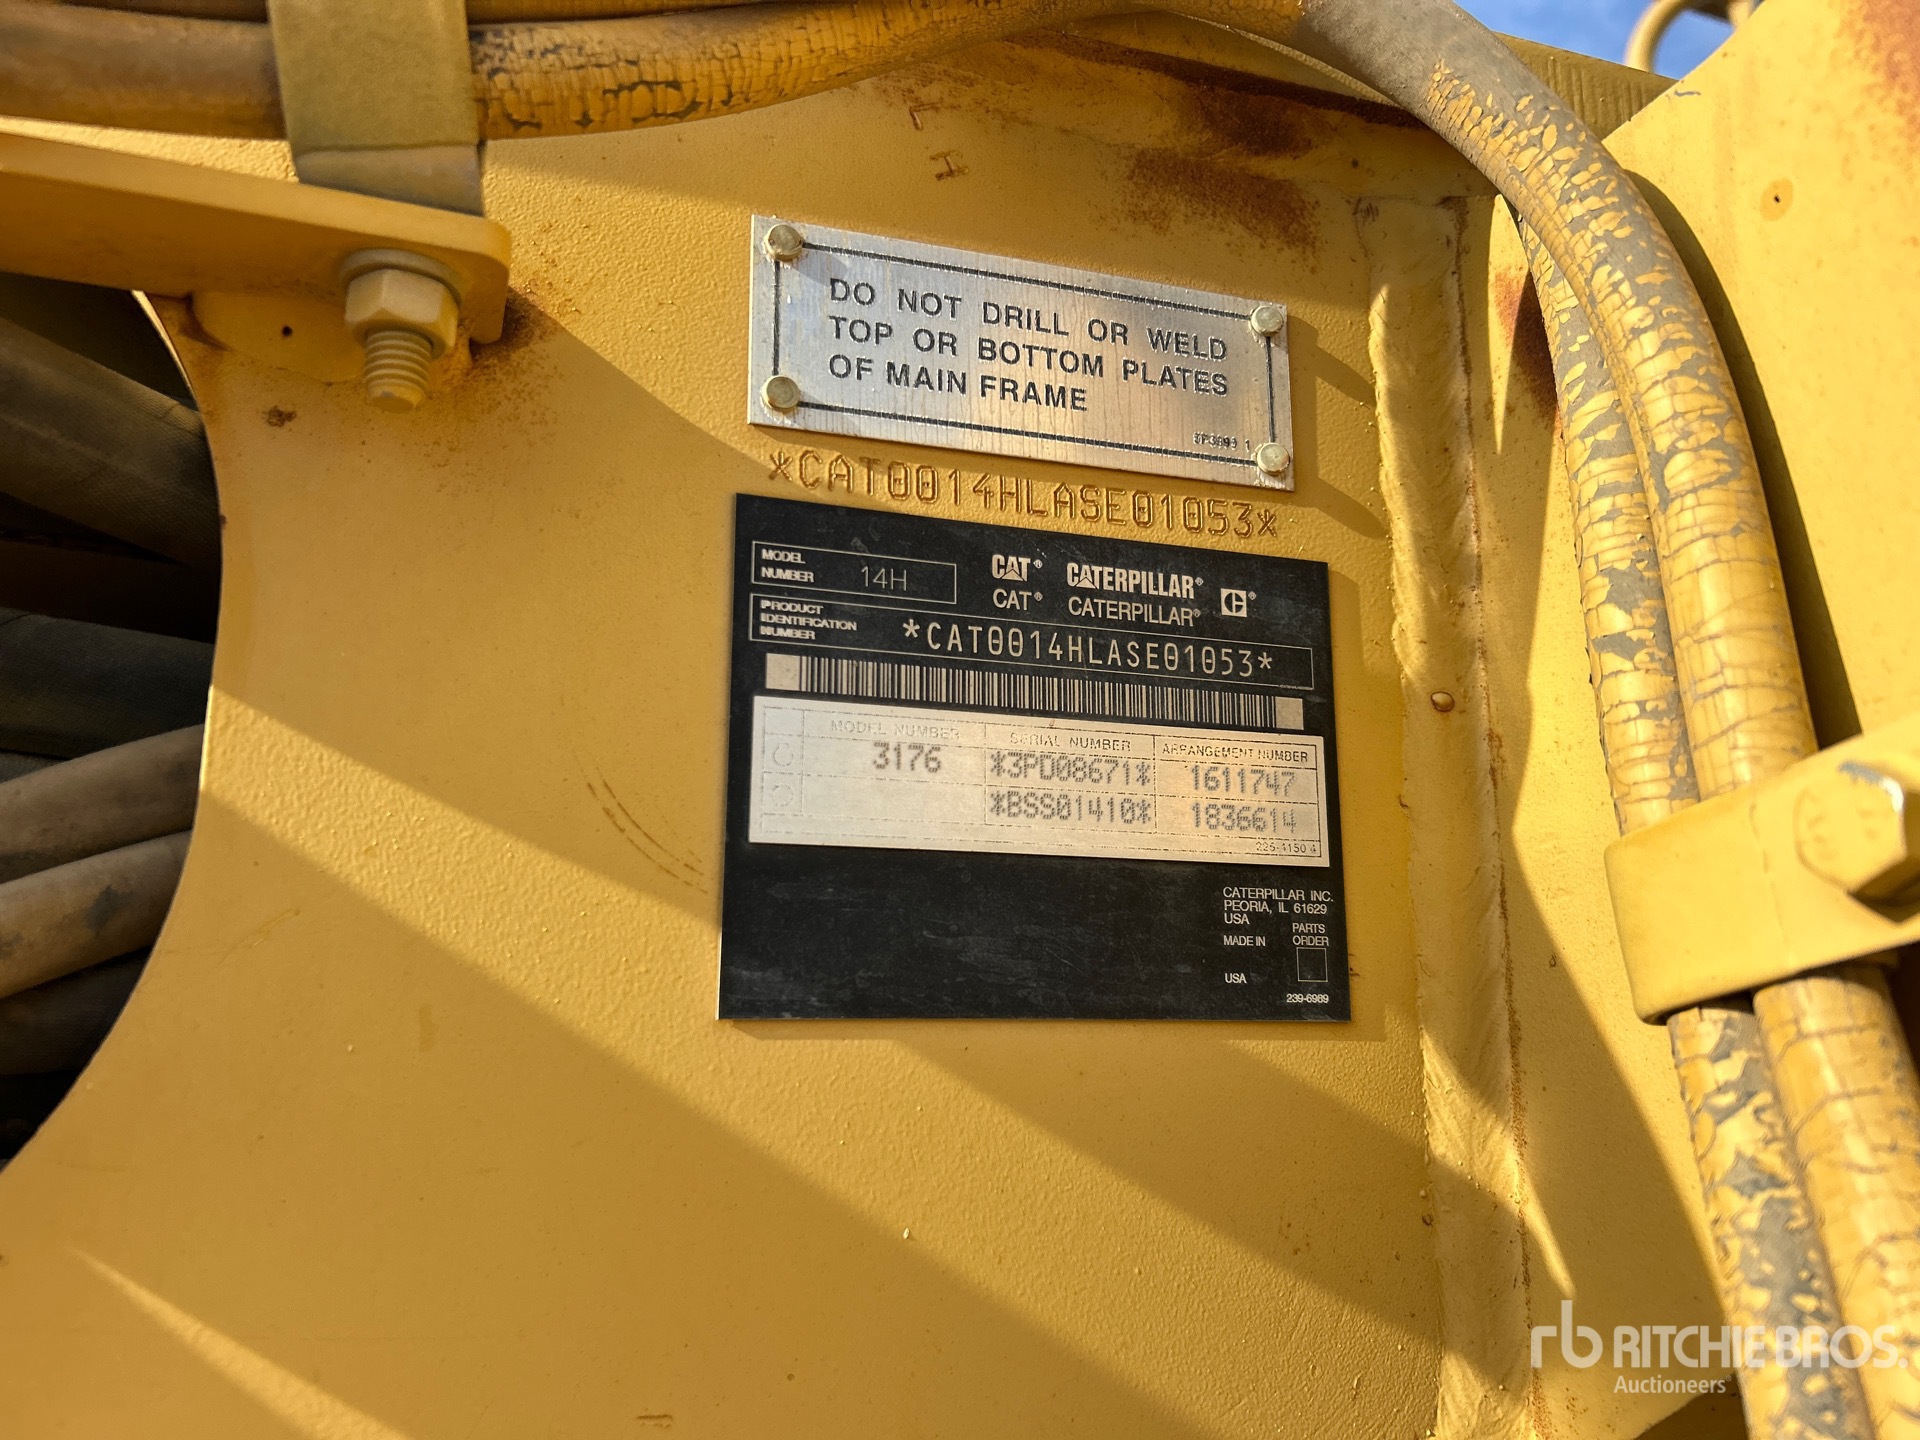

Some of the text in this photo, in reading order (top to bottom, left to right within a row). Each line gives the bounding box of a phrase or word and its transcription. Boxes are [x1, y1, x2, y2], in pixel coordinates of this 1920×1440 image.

[830, 278, 1227, 361] DO NOT DRILL OR WELD
[829, 316, 1228, 396] TOP OR BOTTOM PLATES
[829, 354, 1088, 412] OF MAIN FRAME
[761, 549, 805, 564] MODEL
[761, 567, 814, 583] NUMBER
[861, 566, 907, 591] 14H
[760, 599, 823, 615] PRODUCT
[760, 612, 857, 631] IDENTIFICATION
[759, 626, 816, 640] NUMBER
[831, 719, 960, 740] MODEL NUMBER
[1009, 732, 1131, 752] SERIAL NUMBER
[1162, 743, 1308, 763] ARRANGEMENT NUMBER
[873, 741, 942, 774] 3176
[1192, 765, 1297, 797] 1611747
[1192, 802, 1297, 834] 1836614
[1223, 886, 1334, 902] CATERPILLAR INC.
[1224, 900, 1328, 915] PEORIA, IL 61629
[1224, 912, 1250, 925] USA
[1292, 922, 1326, 934] PARTS
[1223, 935, 1266, 947] MADE IN
[1292, 935, 1330, 947] ORDER
[1224, 972, 1247, 984] USA
